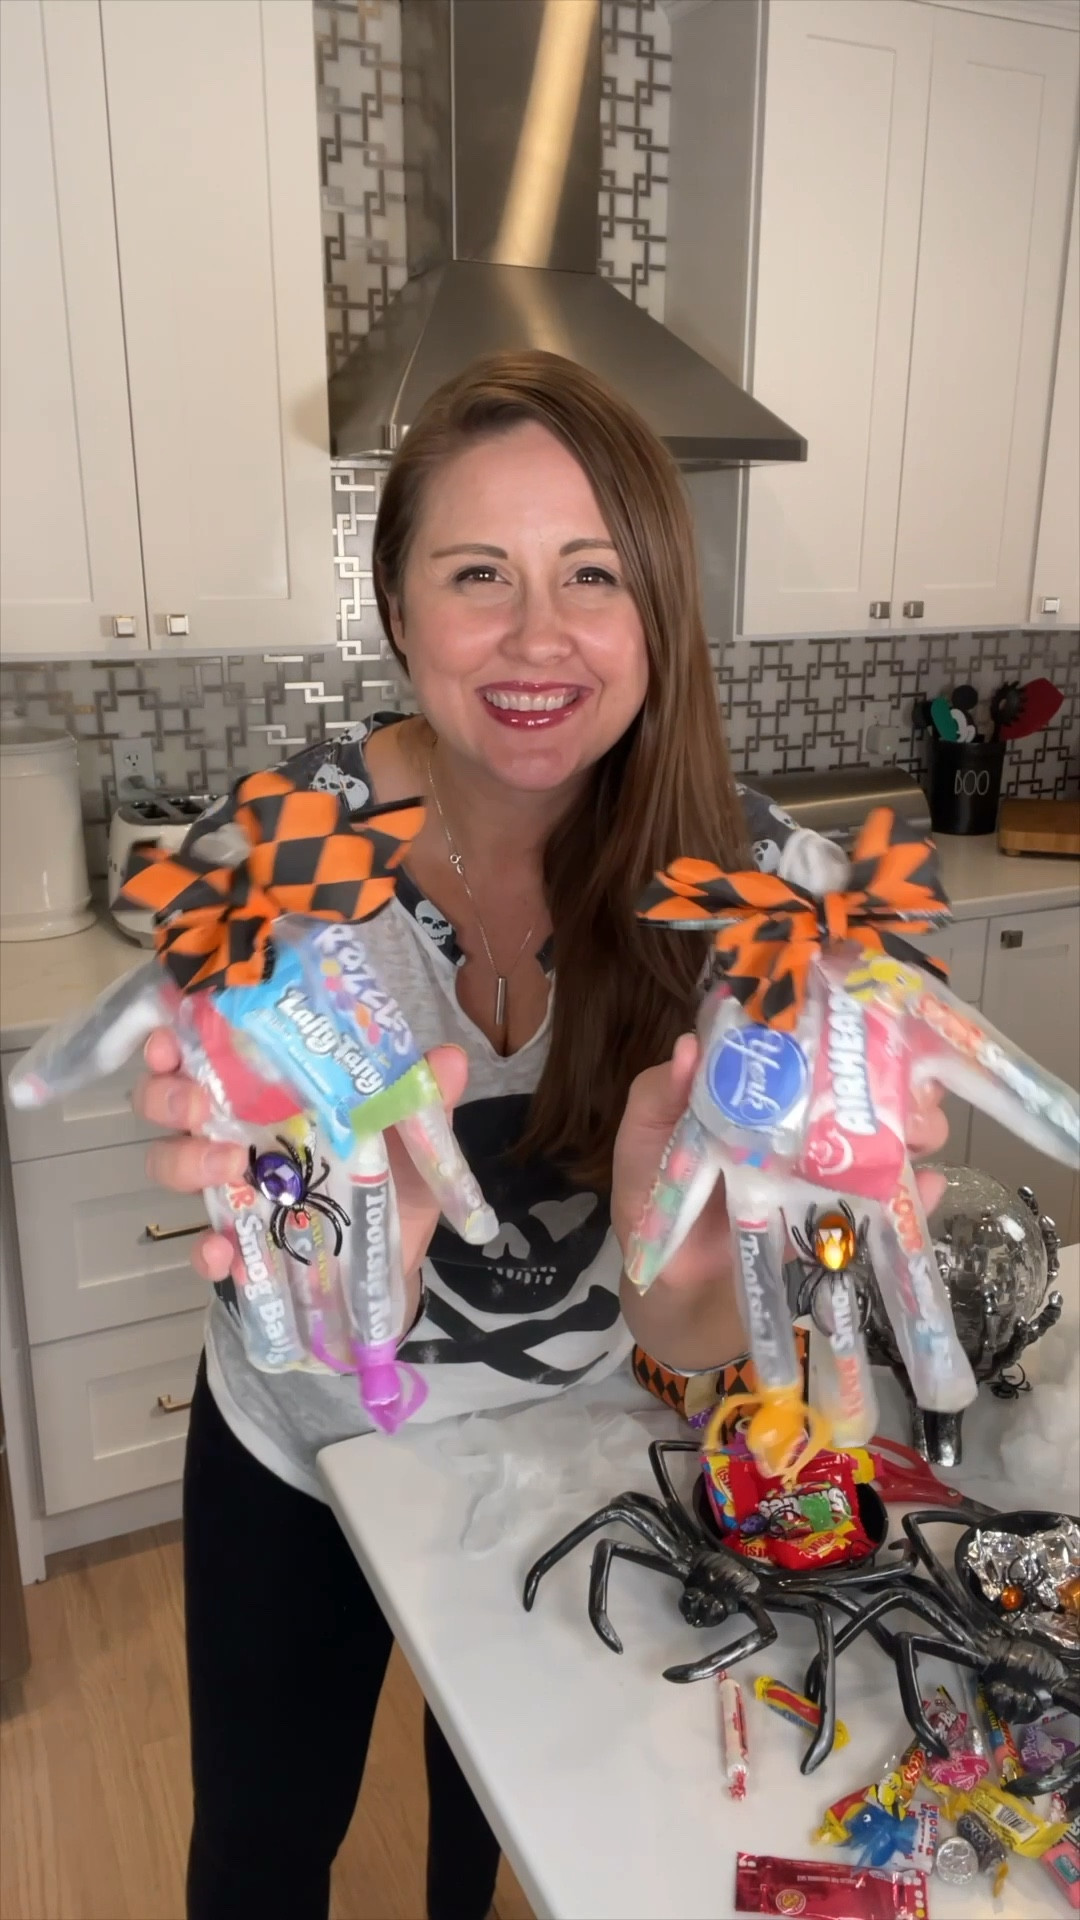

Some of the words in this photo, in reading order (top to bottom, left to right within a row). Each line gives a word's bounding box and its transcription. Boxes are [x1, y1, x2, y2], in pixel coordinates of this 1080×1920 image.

[276, 986, 337, 1055] Laffy
[332, 1034, 386, 1096] Taffy
[827, 987, 878, 1135] AIRHEAD
[235, 1215, 274, 1302] Smog
[258, 1297, 295, 1366] Balls
[363, 1183, 391, 1298] Tootsie
[367, 1296, 392, 1346] Ro
